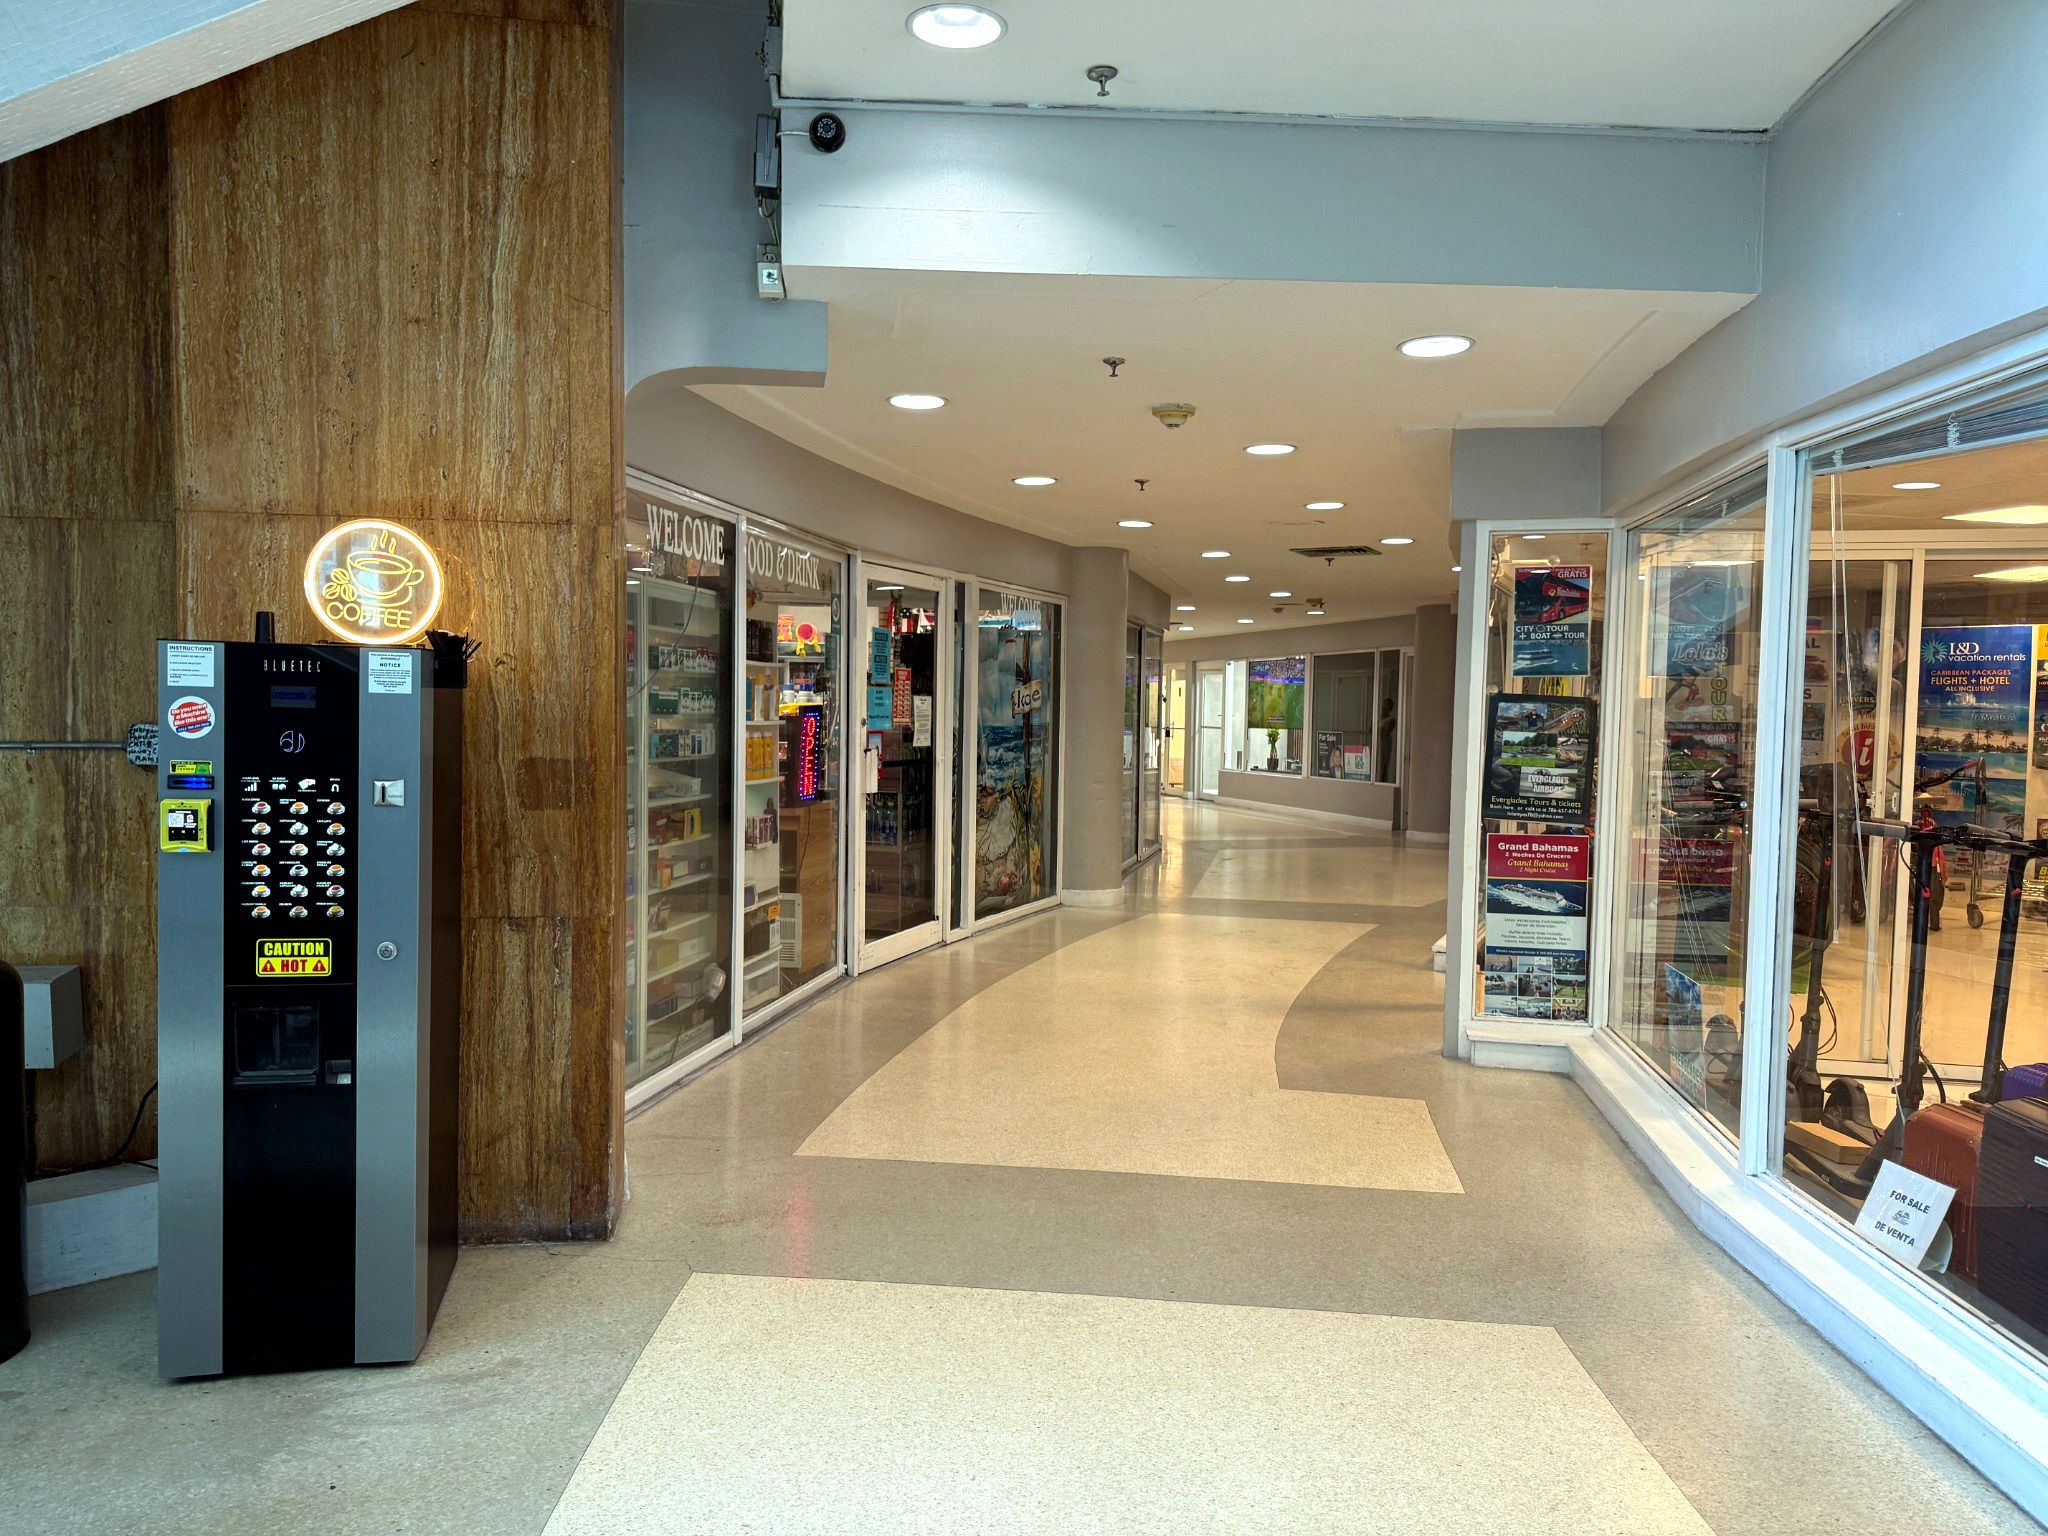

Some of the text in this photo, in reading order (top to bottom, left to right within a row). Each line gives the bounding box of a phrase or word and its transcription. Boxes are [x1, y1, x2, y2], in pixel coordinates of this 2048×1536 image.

[646, 503, 725, 567] WELCOME
[747, 536, 821, 590] OOD & DRINK
[326, 601, 413, 629] COFFEE
[1515, 625, 1534, 633] CITY
[1671, 641, 1729, 662] Lola's
[1949, 642, 1980, 656] I&D
[1948, 653, 2026, 662] vacation rentals
[263, 659, 321, 673] BLUETEC
[1931, 677, 1968, 685] FLIGHTS
[1979, 677, 2010, 685] HOTEL
[1711, 661, 1728, 721] TOUR
[181, 705, 192, 713] you
[191, 702, 208, 711] want
[181, 709, 207, 718] Machine
[1326, 734, 1337, 742] Sale
[1527, 774, 1569, 784] EVERGLADES
[1491, 796, 1527, 805] Everglades
[1558, 800, 1582, 808] tickets
[1498, 843, 1579, 852] Grand Bahamas
[1507, 859, 1569, 868] Grand Bahamas
[264, 942, 325, 956] CAUTION
[280, 959, 308, 973] HOT
[1889, 1190, 1931, 1214] FOR SALE
[1874, 1221, 1915, 1247] DE VENTA
